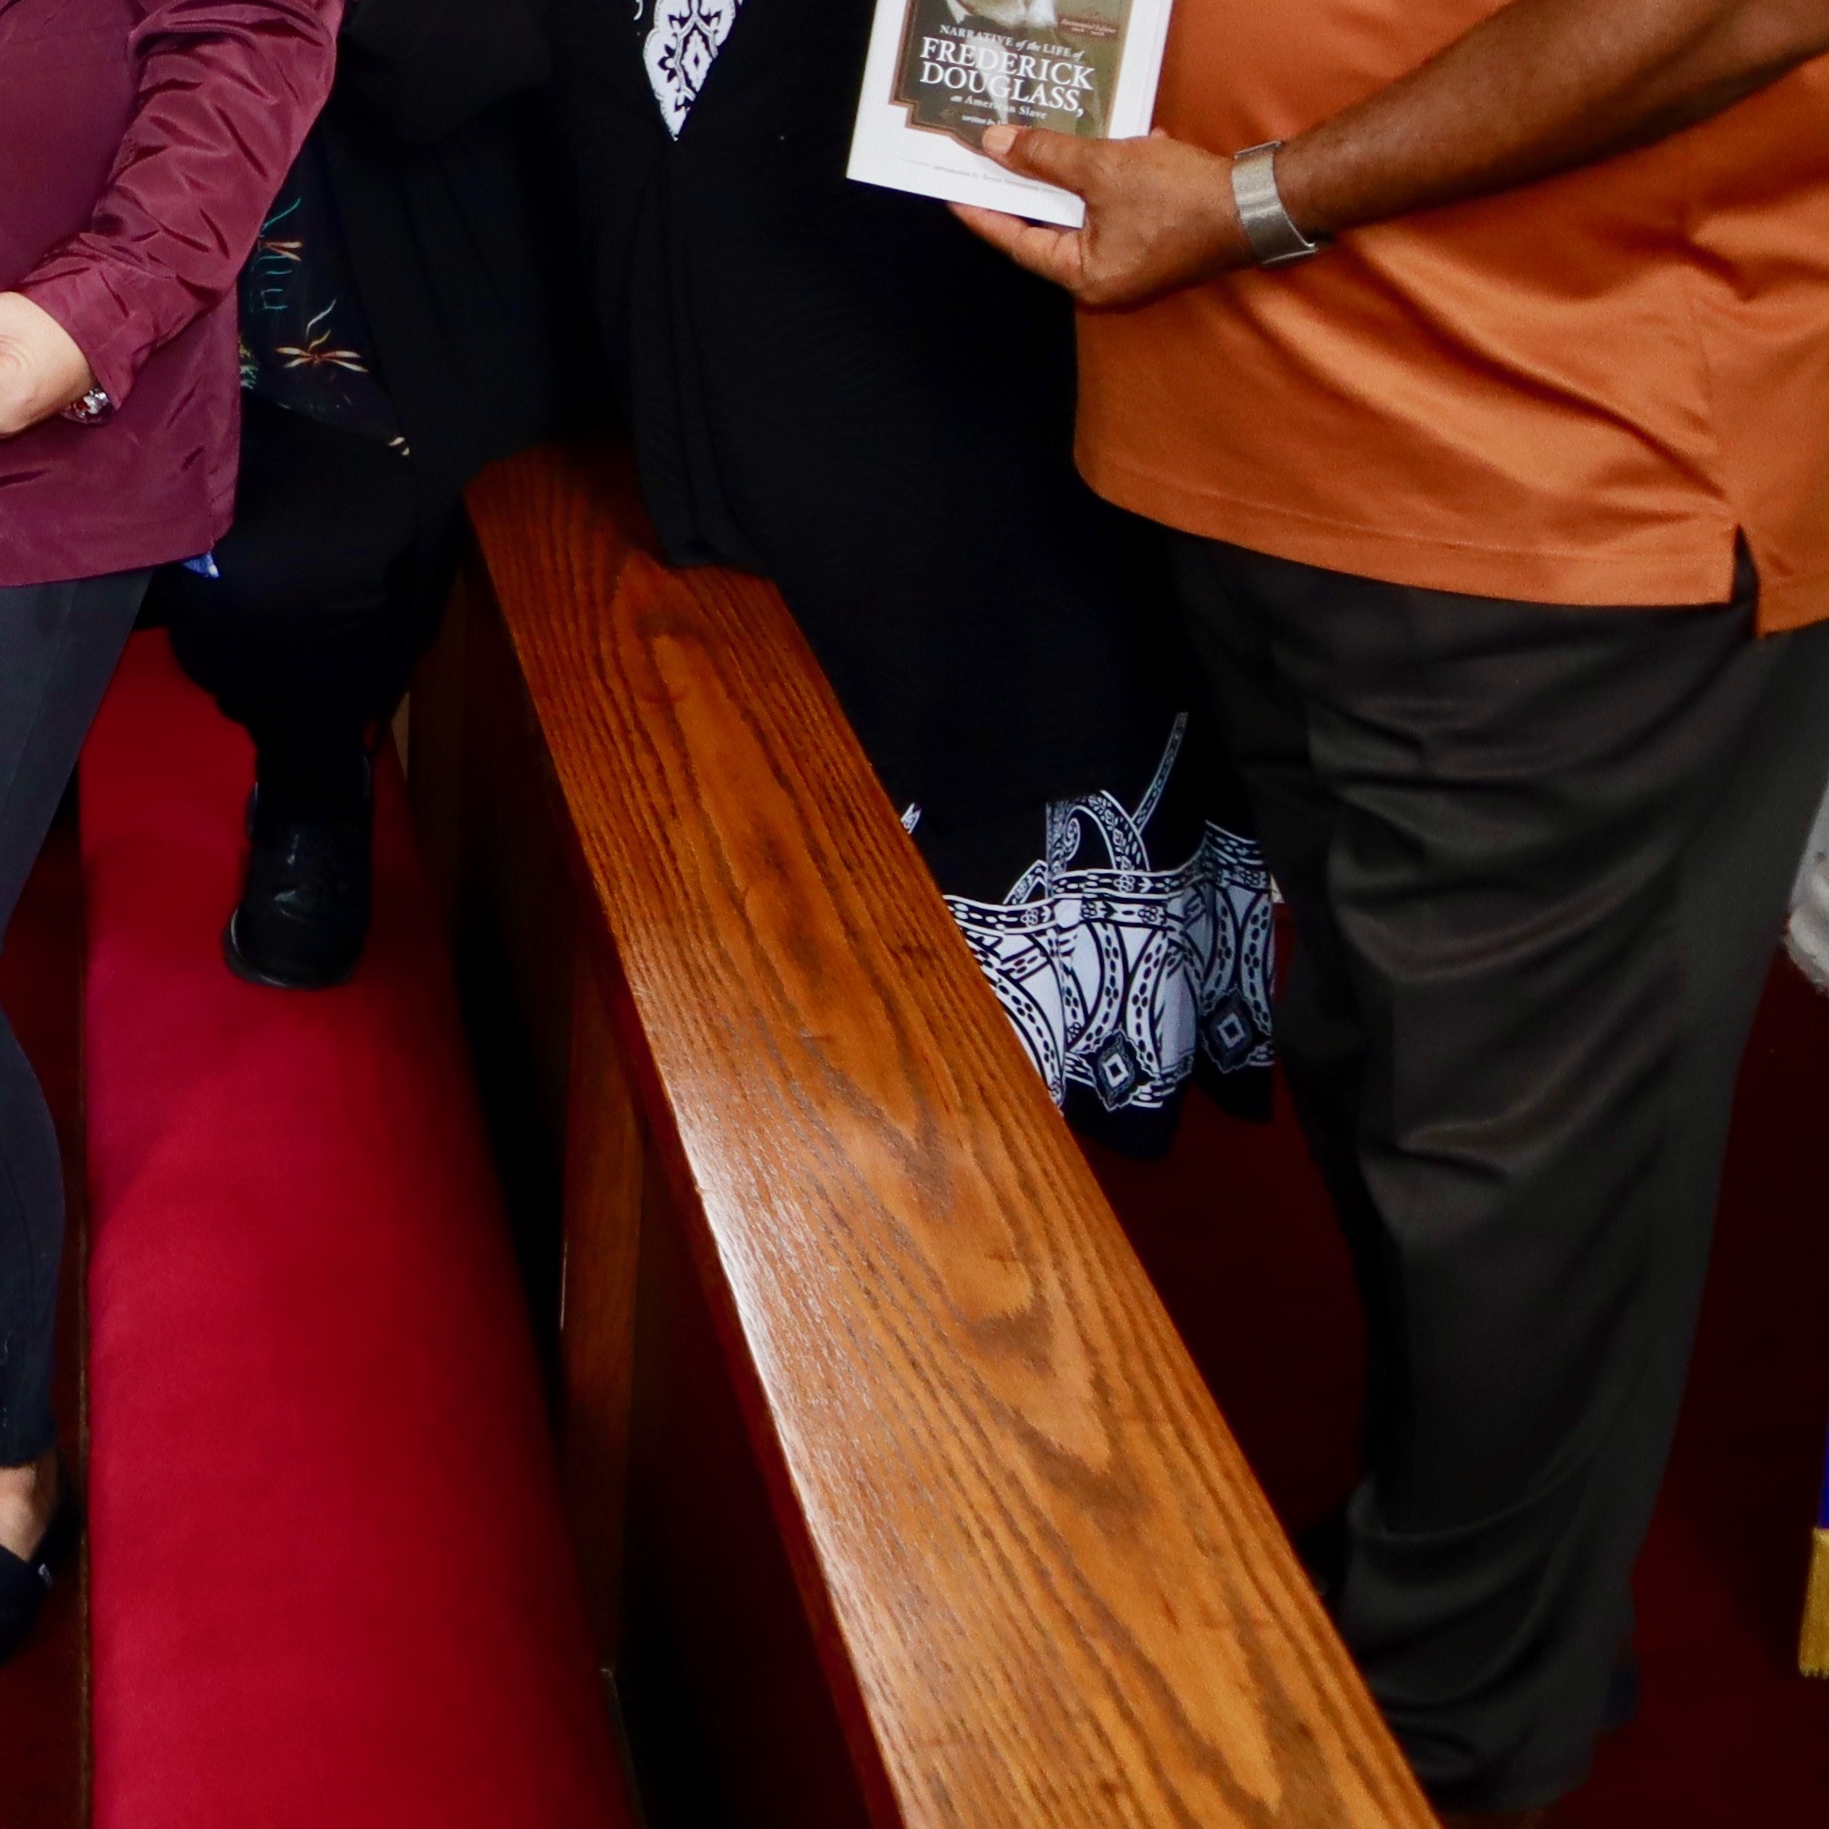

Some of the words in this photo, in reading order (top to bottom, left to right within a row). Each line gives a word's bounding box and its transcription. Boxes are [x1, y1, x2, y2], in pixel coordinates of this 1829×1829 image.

[920, 36, 1095, 90] FREDERICK
[939, 24, 1013, 47] NARRATIVE
[1015, 39, 1028, 51] of
[1027, 40, 1040, 52] the
[1042, 44, 1072, 57] LIFE
[1072, 49, 1085, 62] of
[920, 61, 1085, 117] DOUGLASS,
[965, 94, 1016, 114] American
[1018, 105, 1048, 120] Slave
